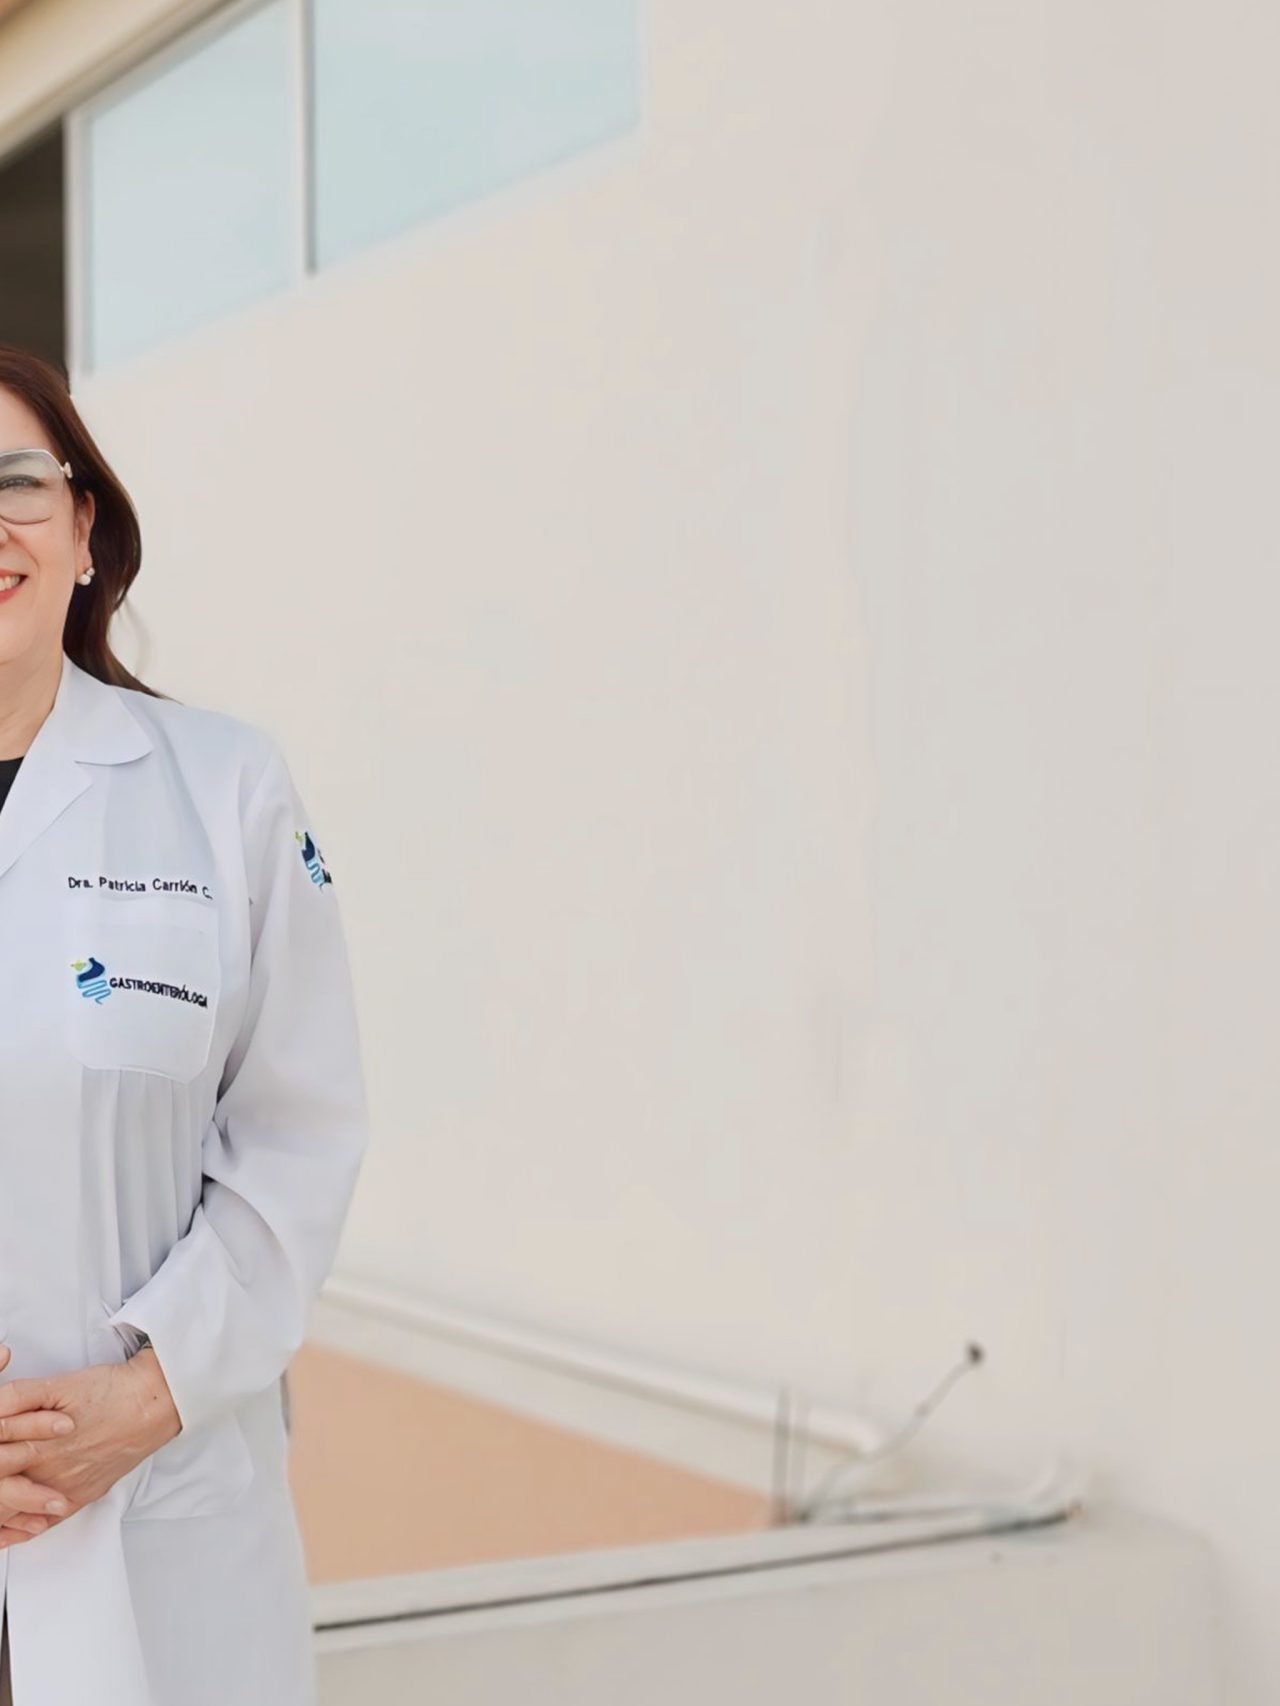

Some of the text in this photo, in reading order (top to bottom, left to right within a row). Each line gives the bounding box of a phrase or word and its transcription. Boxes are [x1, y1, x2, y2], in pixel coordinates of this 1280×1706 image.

[67, 876, 94, 889] Dra.
[99, 875, 147, 892] Patricia
[152, 877, 198, 894] Carrión
